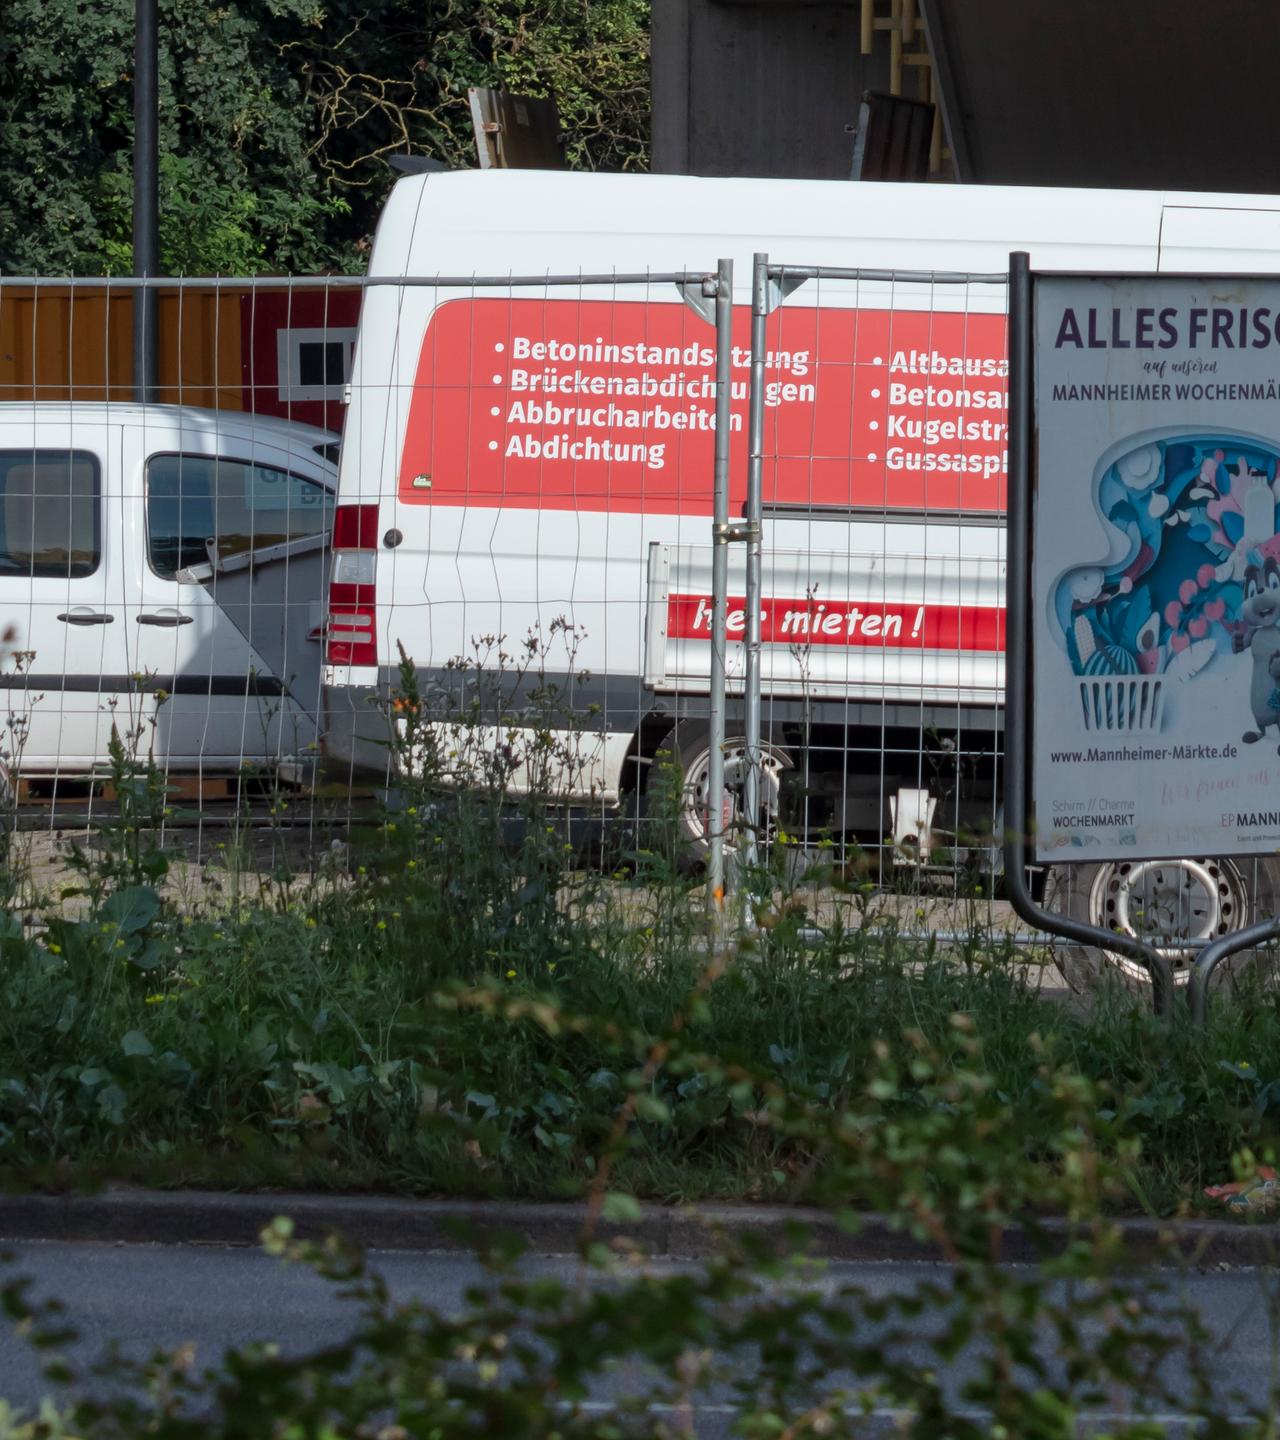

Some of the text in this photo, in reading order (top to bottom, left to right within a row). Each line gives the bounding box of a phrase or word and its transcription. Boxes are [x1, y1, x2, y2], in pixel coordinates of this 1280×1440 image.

[1054, 307, 1179, 350] ALLES
[513, 336, 810, 376] Betoninstandstzng
[1143, 359, 1218, 378] auf unseren
[511, 367, 815, 407] Brückenabdichugen
[1052, 383, 1172, 401] MANNHEIMER
[505, 433, 666, 469] Abdichtung
[693, 599, 767, 631] he
[781, 605, 902, 637] mieten
[1050, 745, 1238, 763] www.Mannheimer-Märkte.de
[1052, 799, 1086, 812] Schirm
[1099, 797, 1135, 811] Charme
[1053, 814, 1135, 828] WOCHENMARKT
